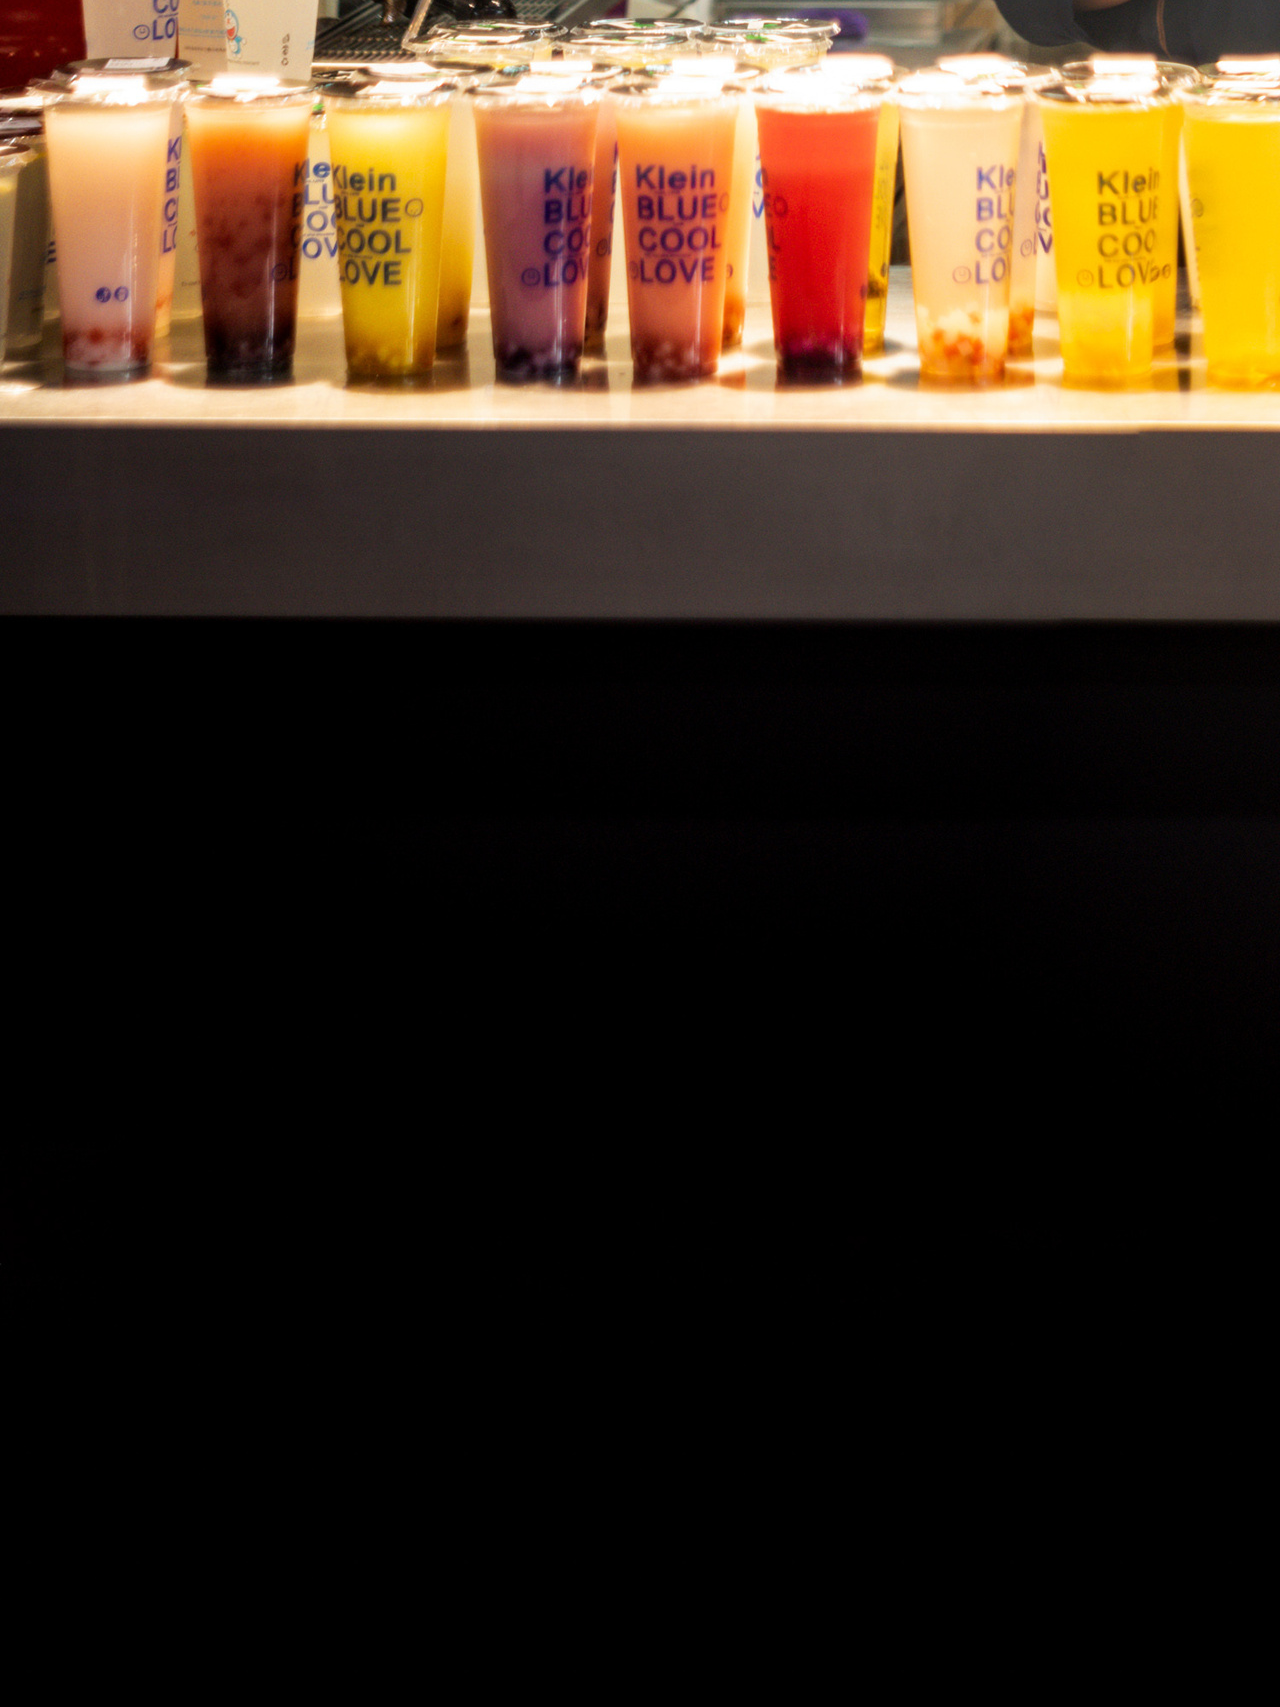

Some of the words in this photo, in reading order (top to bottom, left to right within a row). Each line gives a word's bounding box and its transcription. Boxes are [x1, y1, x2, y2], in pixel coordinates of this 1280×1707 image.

[332, 164, 397, 192] Klein
[635, 163, 716, 192] Klein
[335, 196, 401, 223] BLUE
[637, 193, 718, 222] BLUE
[638, 225, 722, 253] COOL
[639, 256, 715, 284] LOVE
